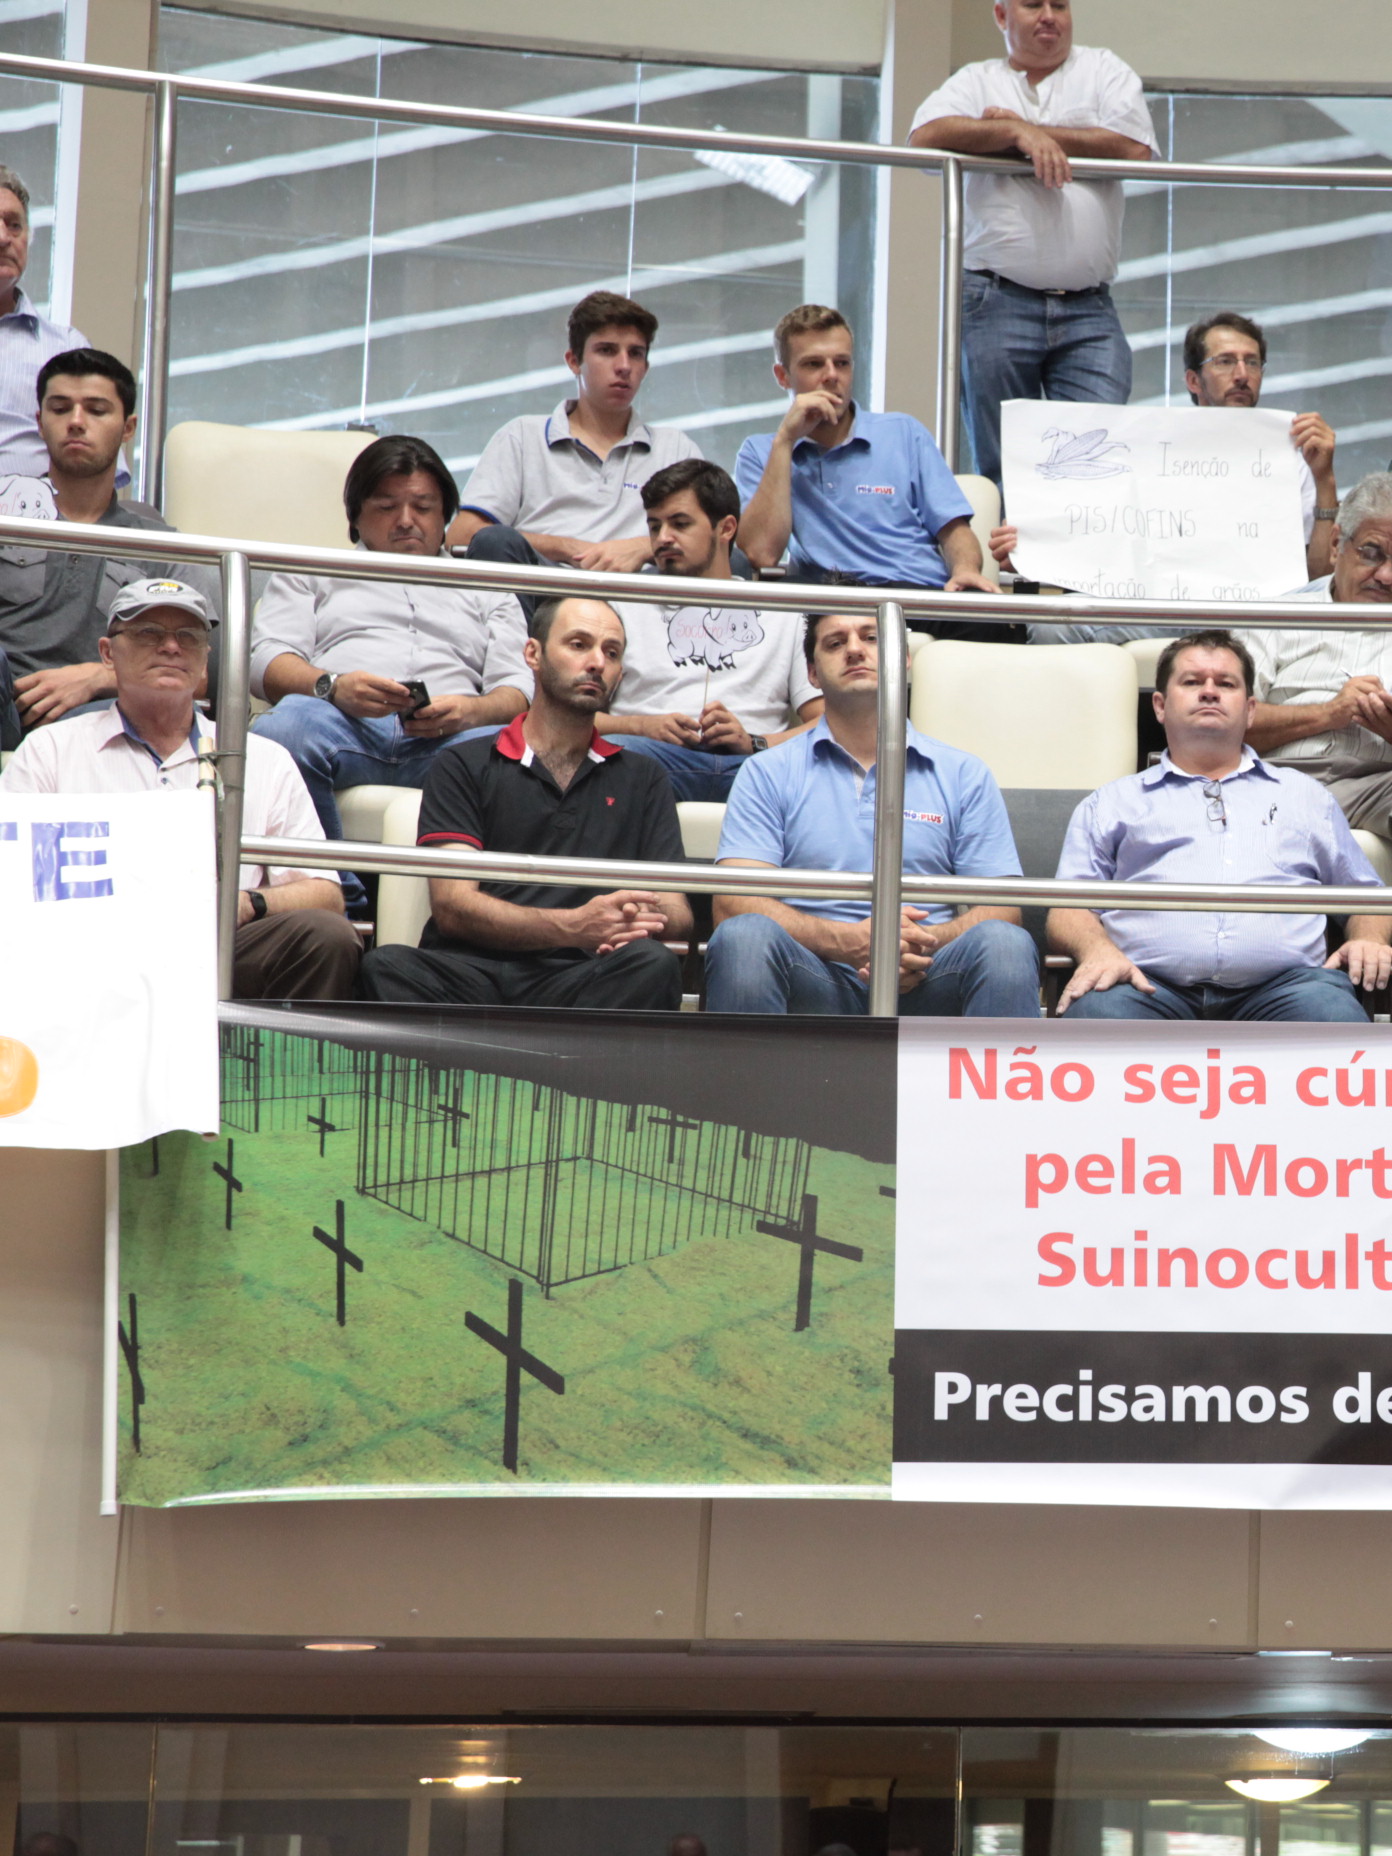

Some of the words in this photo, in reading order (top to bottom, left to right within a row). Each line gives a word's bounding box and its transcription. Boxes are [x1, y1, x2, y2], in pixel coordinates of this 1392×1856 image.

[1156, 441, 1229, 478] Isenção
[1251, 448, 1272, 478] de
[1064, 503, 1196, 540] PIS/COFINS
[1237, 521, 1260, 539] na
[1170, 573, 1191, 601] de
[0, 821, 114, 902] E
[948, 1045, 1095, 1103] Não
[1124, 1049, 1267, 1120] seja
[1024, 1137, 1182, 1209] pela
[934, 1369, 1310, 1424] Precisamos
